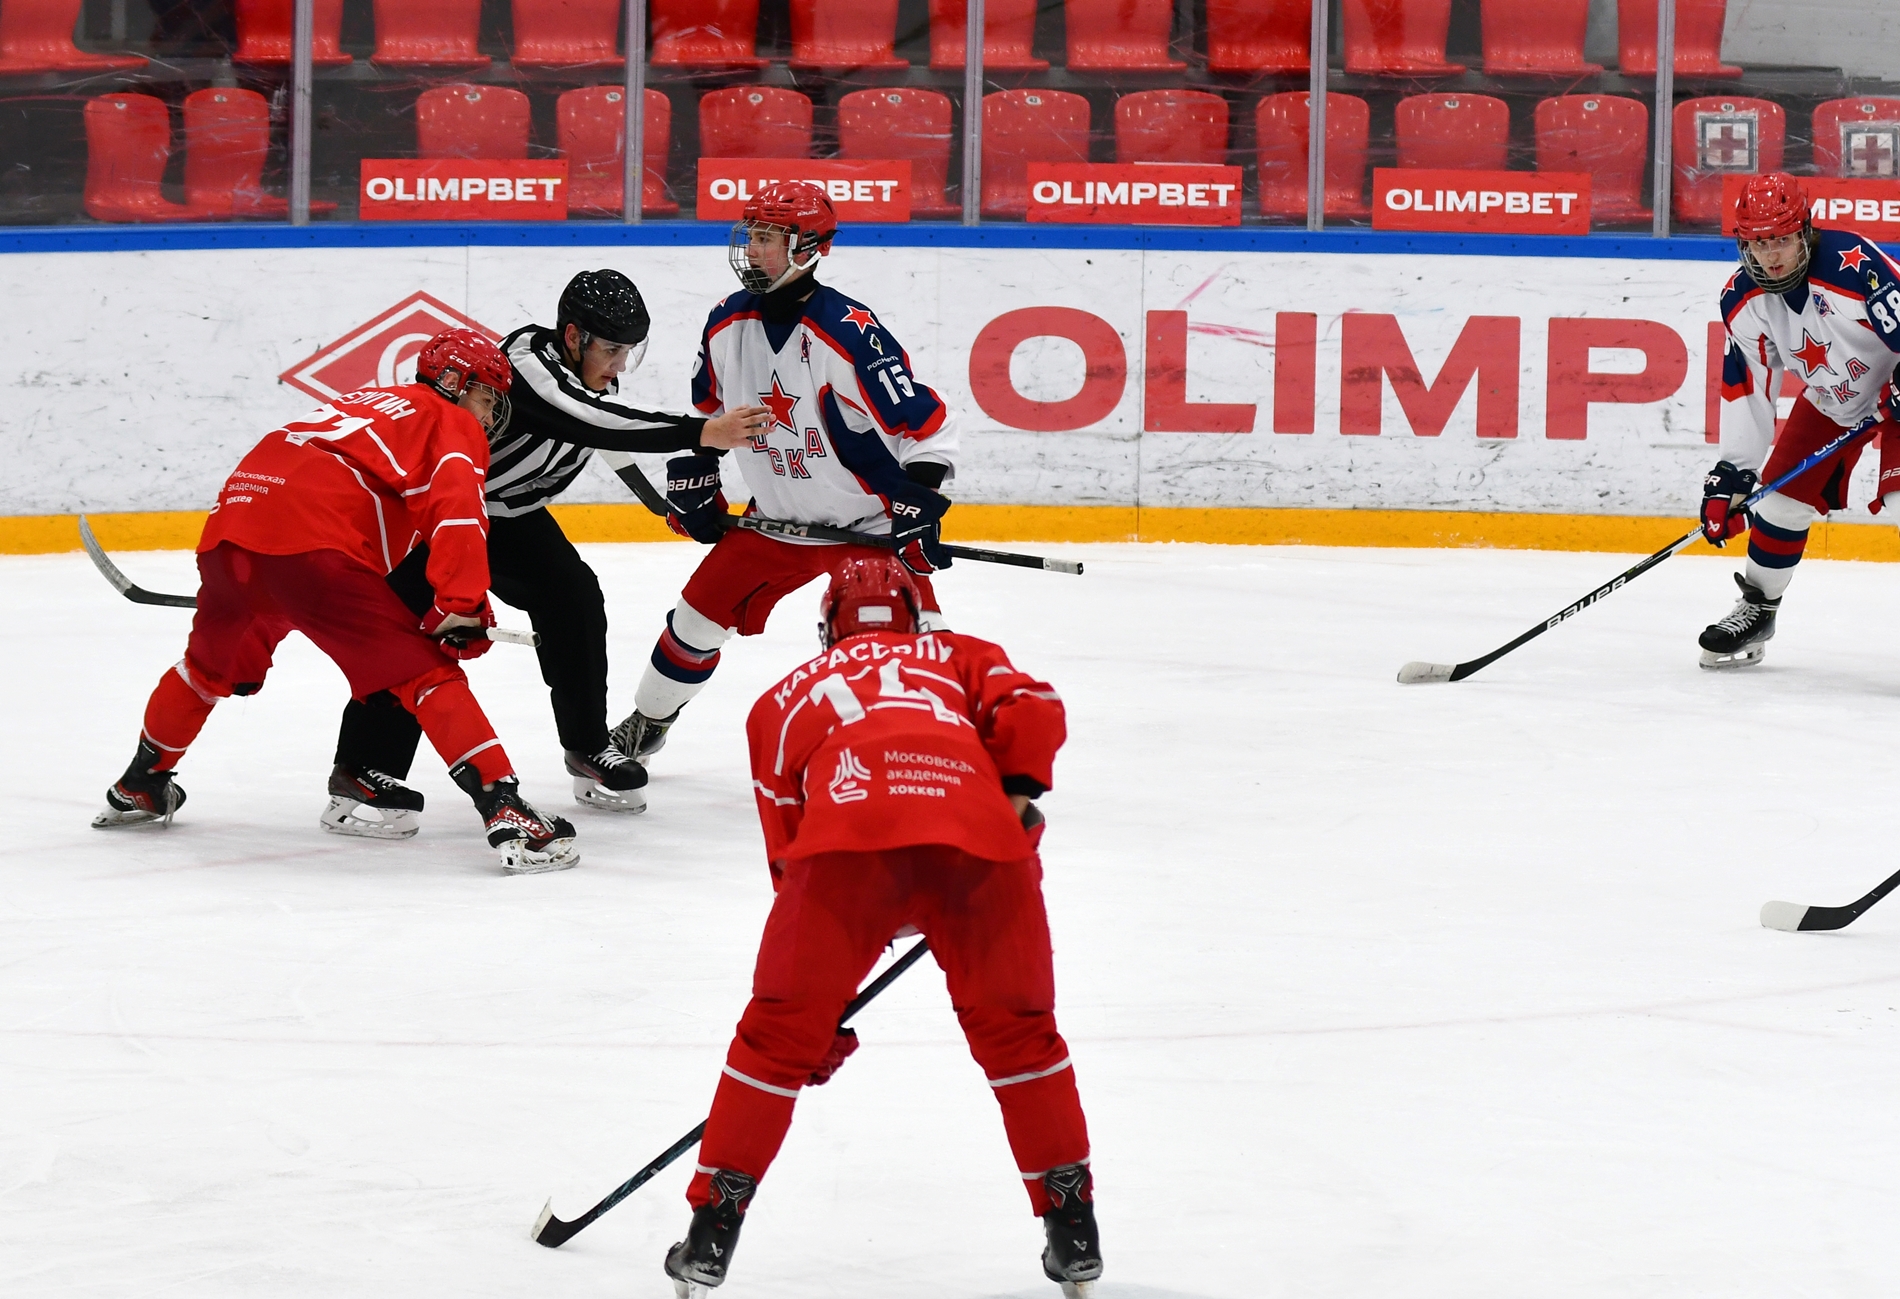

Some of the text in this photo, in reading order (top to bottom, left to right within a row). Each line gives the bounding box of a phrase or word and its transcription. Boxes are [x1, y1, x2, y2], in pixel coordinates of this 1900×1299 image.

[366, 177, 562, 202] OLIMPBET
[709, 178, 899, 202] OLBET
[1033, 181, 1236, 207] OLIMPBET
[1385, 188, 1578, 215] OLIMPBET
[877, 364, 916, 406] 15
[968, 305, 1725, 445] OLIMP
[227, 482, 269, 495] академия
[231, 470, 286, 486] Московская
[737, 518, 808, 538] CCM
[1546, 576, 1627, 630] BAUER
[809, 658, 961, 727] 14
[884, 750, 976, 774] Московская
[886, 769, 962, 786] академия
[888, 784, 946, 798] хоккея
